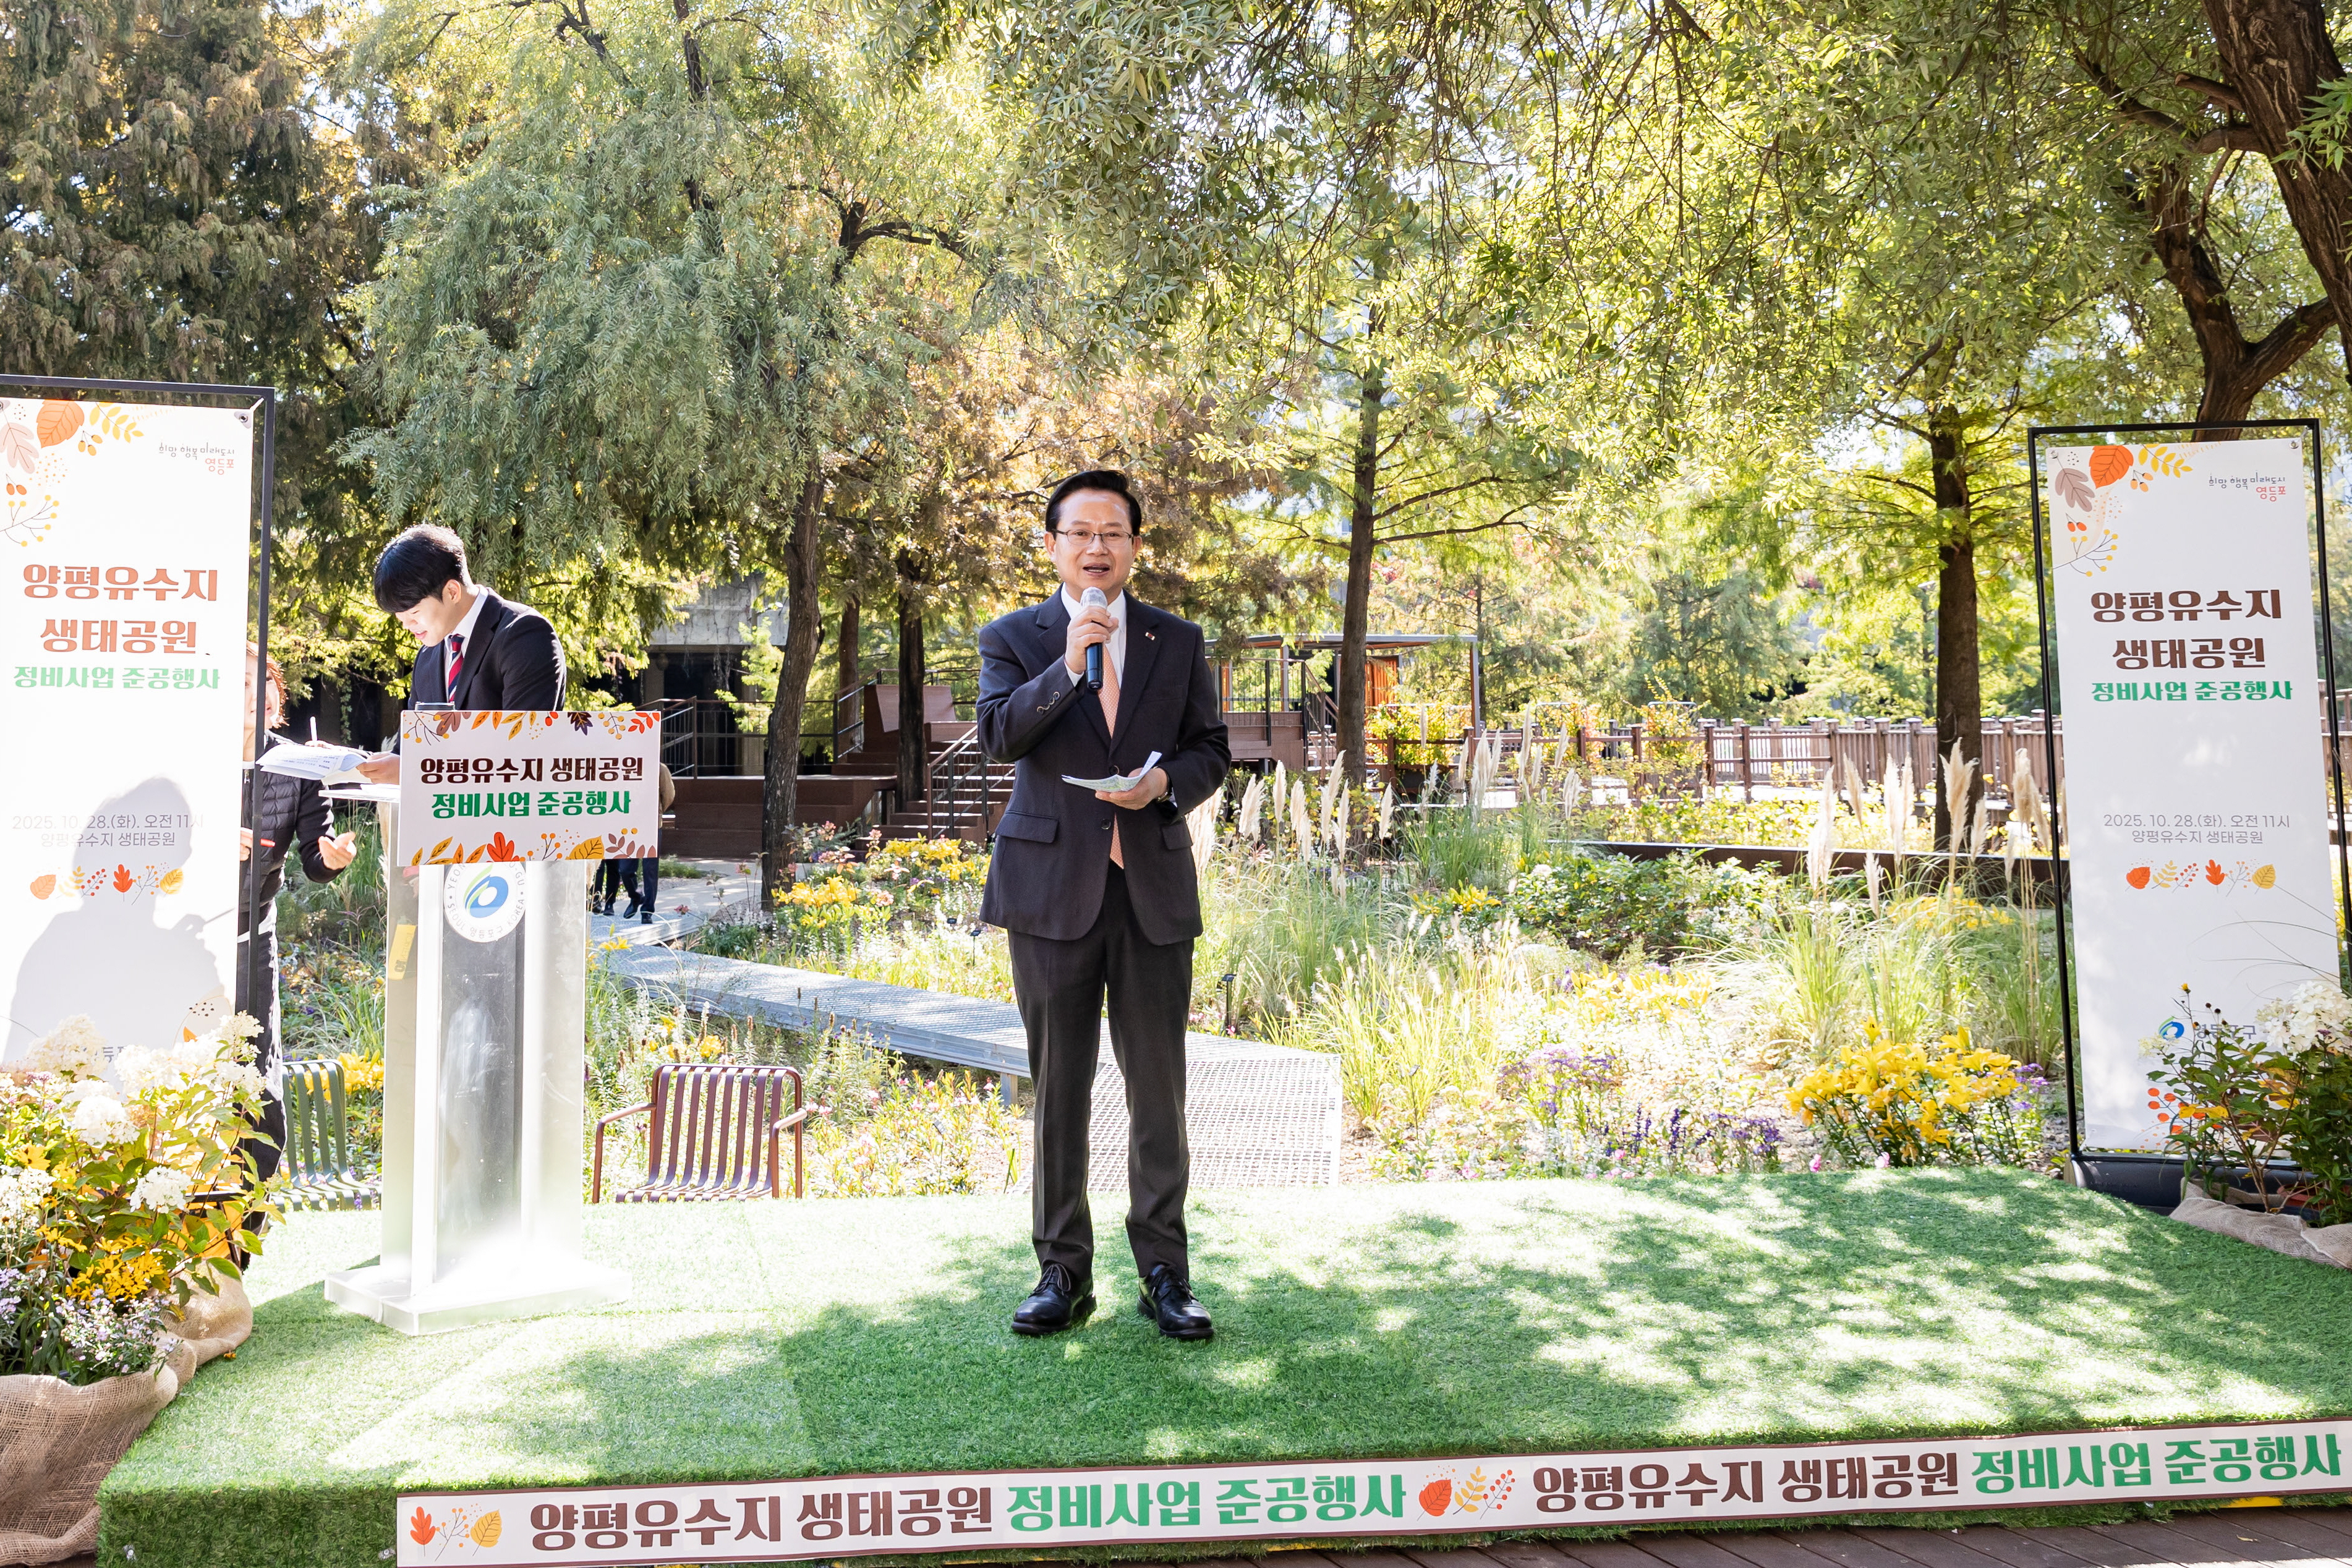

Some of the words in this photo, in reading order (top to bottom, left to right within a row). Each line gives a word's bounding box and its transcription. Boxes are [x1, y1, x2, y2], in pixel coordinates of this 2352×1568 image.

[205, 458, 234, 475] 영등포
[2230, 475, 2248, 490] 행복
[2256, 486, 2286, 502] 영등포
[23, 564, 218, 602] 양평유수지
[2090, 589, 2282, 623] 양평유수지
[40, 619, 197, 654] 생태공원
[2112, 637, 2266, 670] 생태공원
[13, 666, 114, 688] 정비사업
[122, 667, 220, 689] 준공행사
[2091, 681, 2187, 702] 정비사업
[2194, 680, 2293, 701] 준공행사
[420, 757, 543, 784] 양평유수지
[550, 757, 643, 782] 생태공원
[431, 791, 530, 819] 정비사업
[537, 791, 631, 816] 준공행사
[144, 814, 172, 829] 오전
[176, 814, 203, 829] 11시
[2103, 814, 2146, 827] 2025.
[2230, 815, 2258, 828] 오전
[2262, 815, 2290, 828] 11시
[41, 832, 113, 847] 양평유수지
[118, 832, 175, 846] 생태공원
[2132, 830, 2202, 843] 양평유수지
[2205, 830, 2264, 844] 생태공원
[448, 903, 466, 931] SEOUL
[507, 898, 525, 926] KOREA
[470, 926, 503, 939] 영등포구
[530, 1496, 781, 1551] 양평유수지
[796, 1487, 992, 1541] 생태공원
[1006, 1481, 1200, 1532] 정비사업
[1216, 1474, 1406, 1525] 준공행사
[1533, 1460, 1763, 1513] 양평유수지
[1778, 1452, 1959, 1502] 생태공원
[1972, 1442, 2151, 1494] 정비사업
[2165, 1433, 2341, 1484] 준공행사
